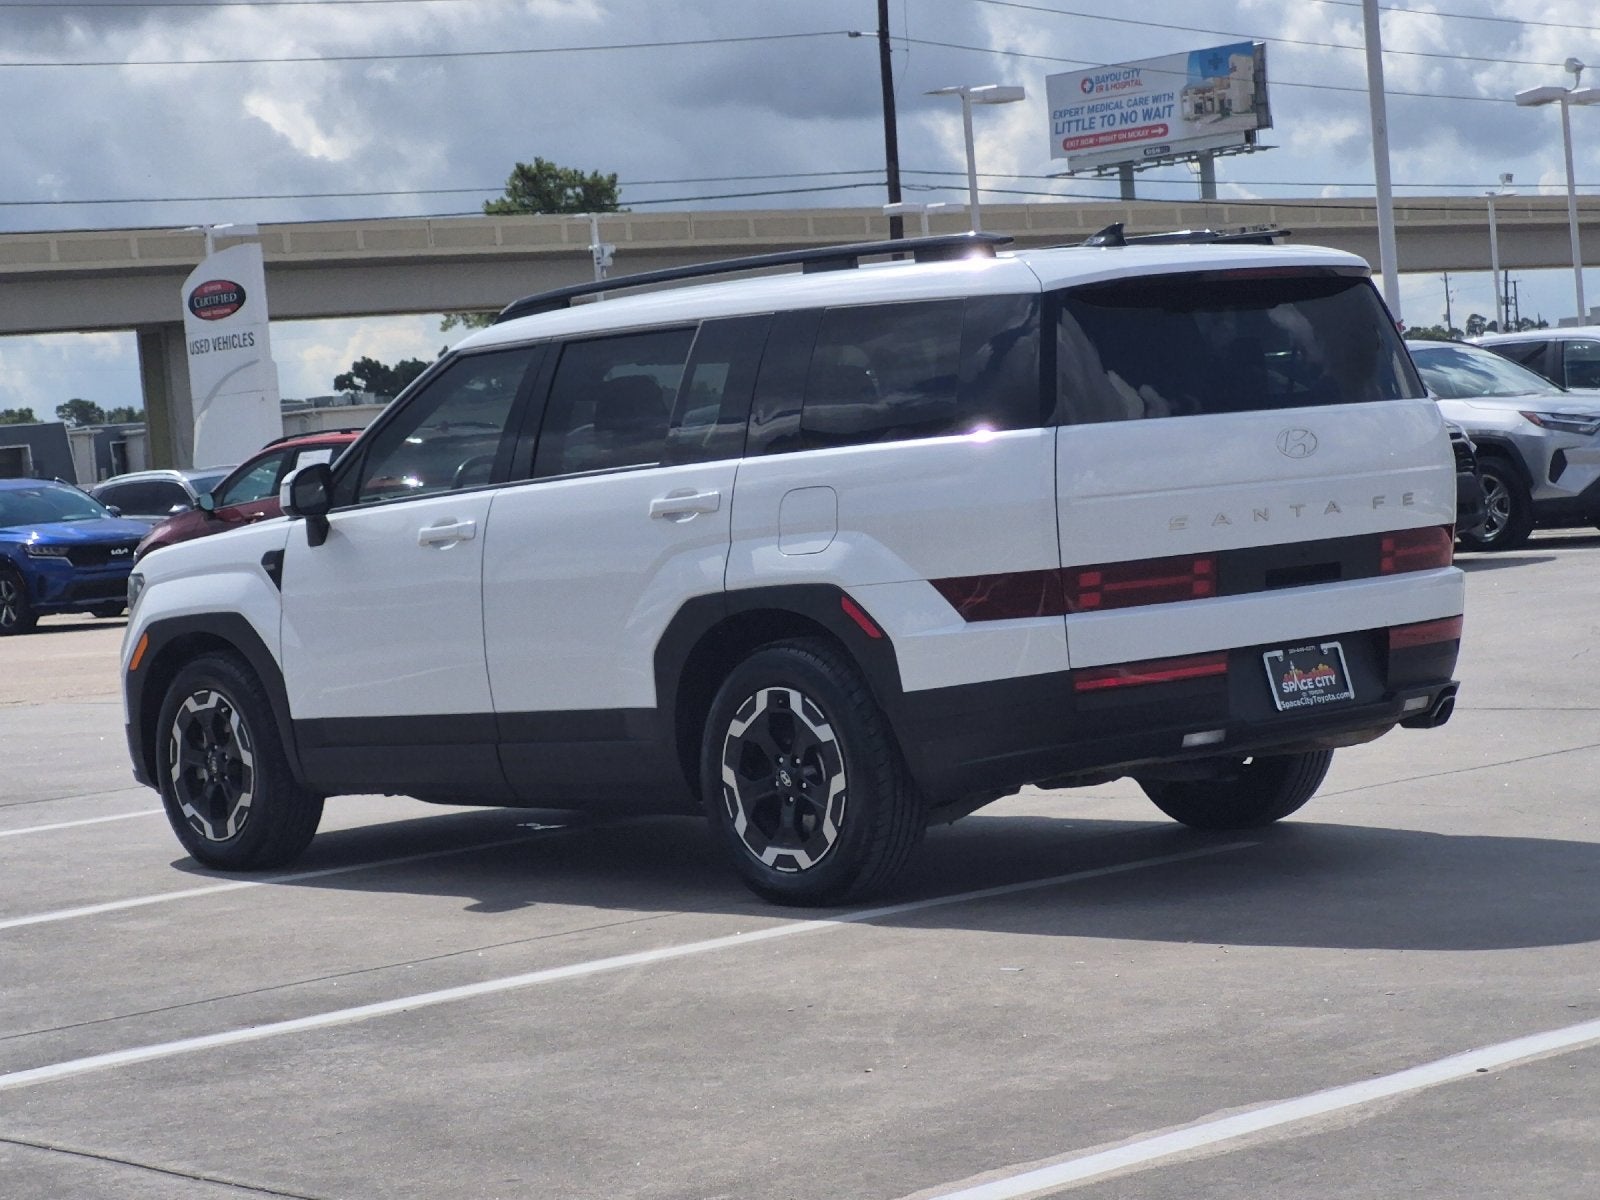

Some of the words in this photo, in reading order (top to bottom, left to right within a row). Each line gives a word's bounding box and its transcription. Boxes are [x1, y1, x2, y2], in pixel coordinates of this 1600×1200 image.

[1123, 68, 1141, 80] CITY
[1110, 79, 1143, 91] HOSPITAL
[1053, 106, 1085, 119] EXPERT
[1087, 101, 1123, 114] MEDICAL
[1126, 97, 1150, 107] CARE
[1151, 92, 1175, 103] WITH
[1054, 116, 1096, 135] LITTLE
[1098, 113, 1116, 128] TO
[1119, 109, 1138, 125] NO
[1142, 104, 1175, 121] WAIT
[189, 338, 211, 356] USED
[211, 332, 255, 351] VEHICLES
[1168, 500, 1342, 531] SANTA
[1372, 492, 1414, 510] FE
[1282, 679, 1315, 693] SPACE
[1315, 674, 1336, 687] CITY
[1280, 691, 1351, 710] SpaceCityToyota.com
